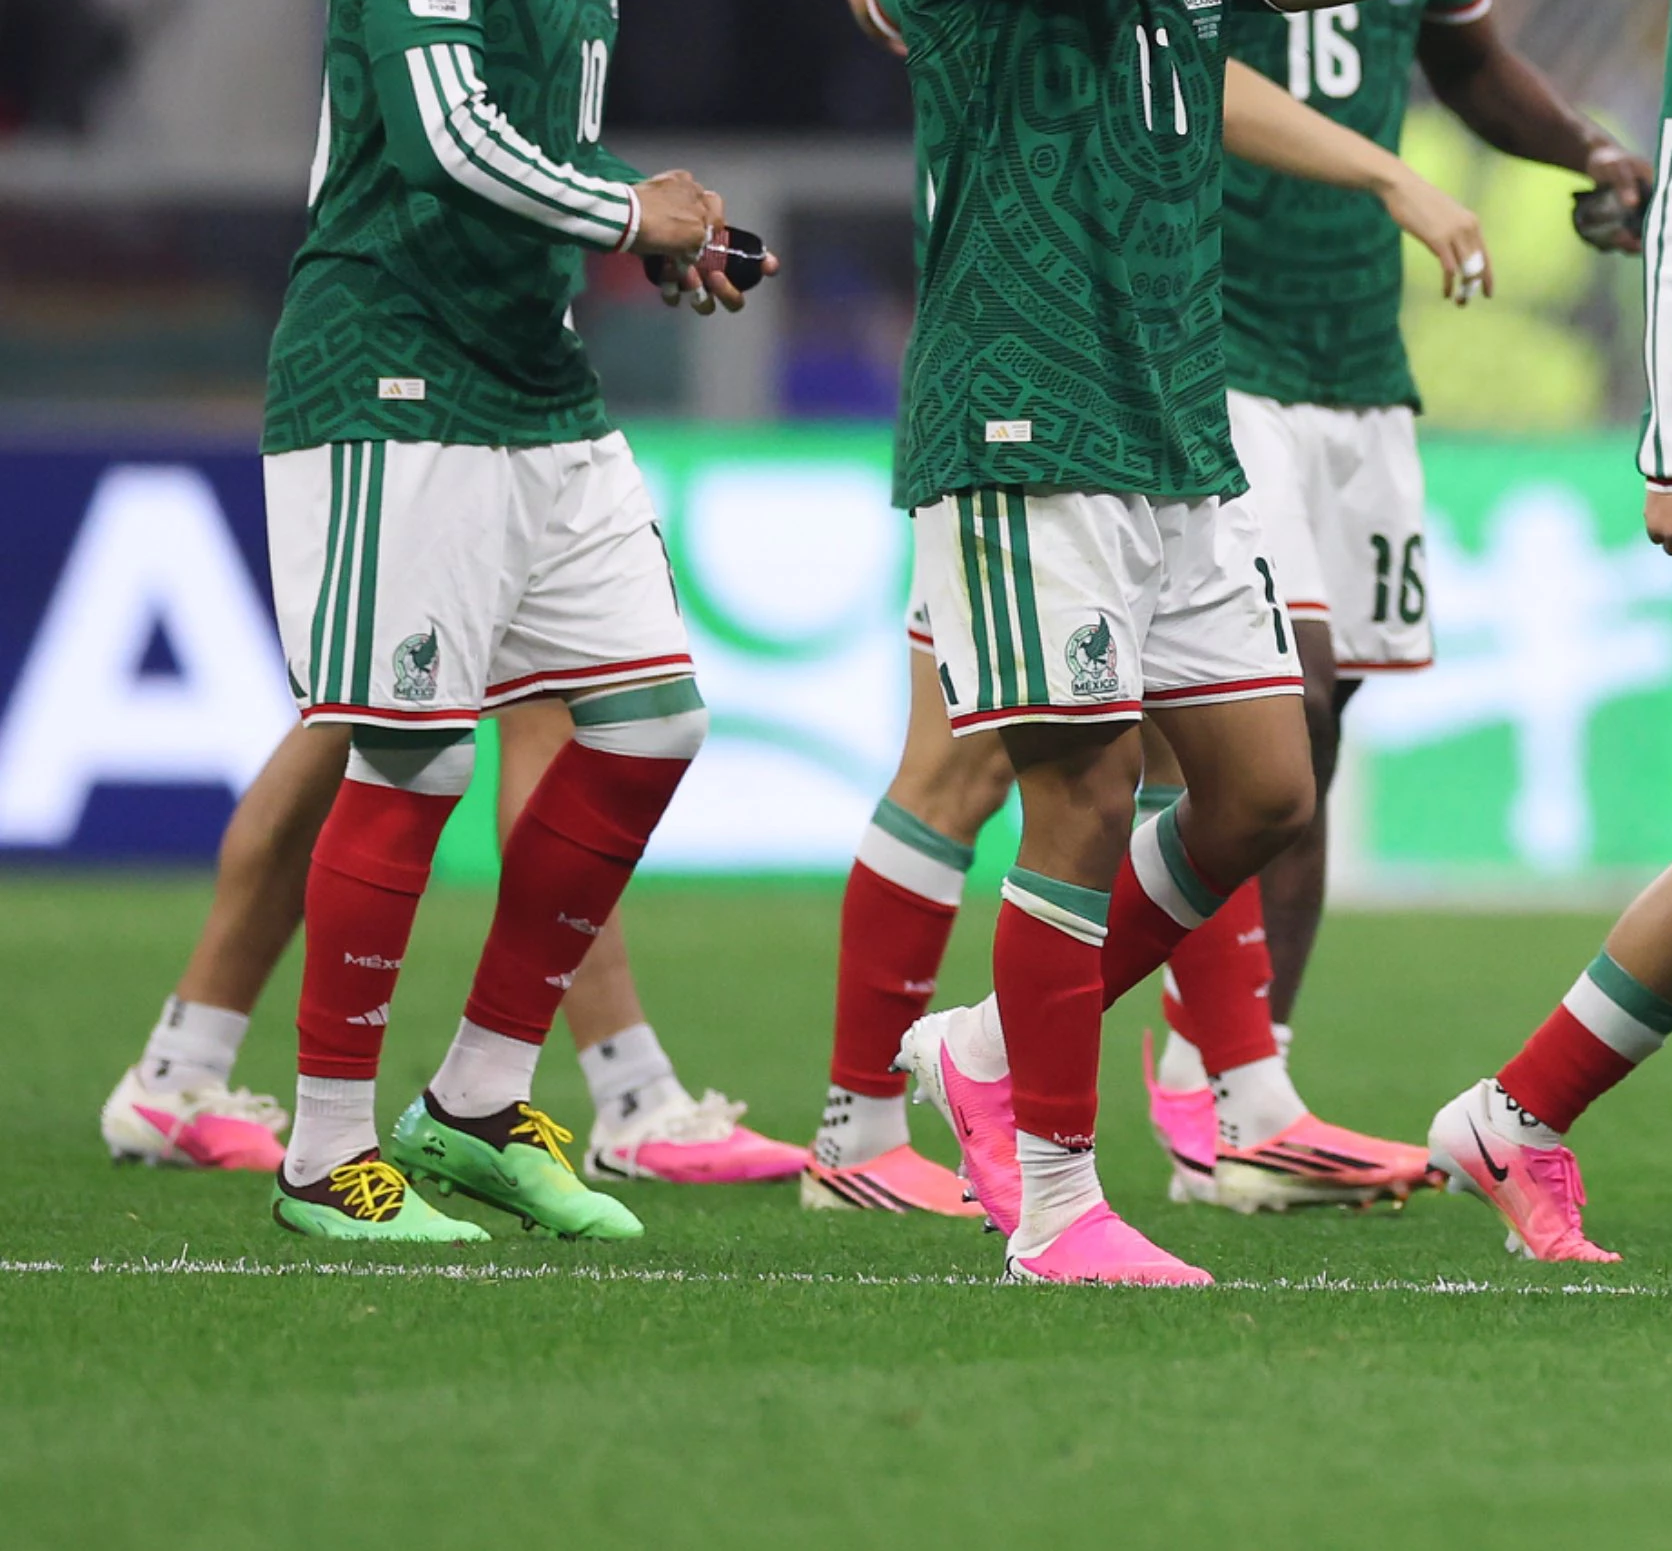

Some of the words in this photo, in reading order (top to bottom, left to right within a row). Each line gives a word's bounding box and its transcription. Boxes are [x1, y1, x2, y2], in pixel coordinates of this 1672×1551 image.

[576, 39, 608, 143] 10
[1283, 3, 1362, 101] 16
[1371, 532, 1425, 625] 16
[0, 464, 300, 848] A
[1074, 678, 1117, 691] MEXICO
